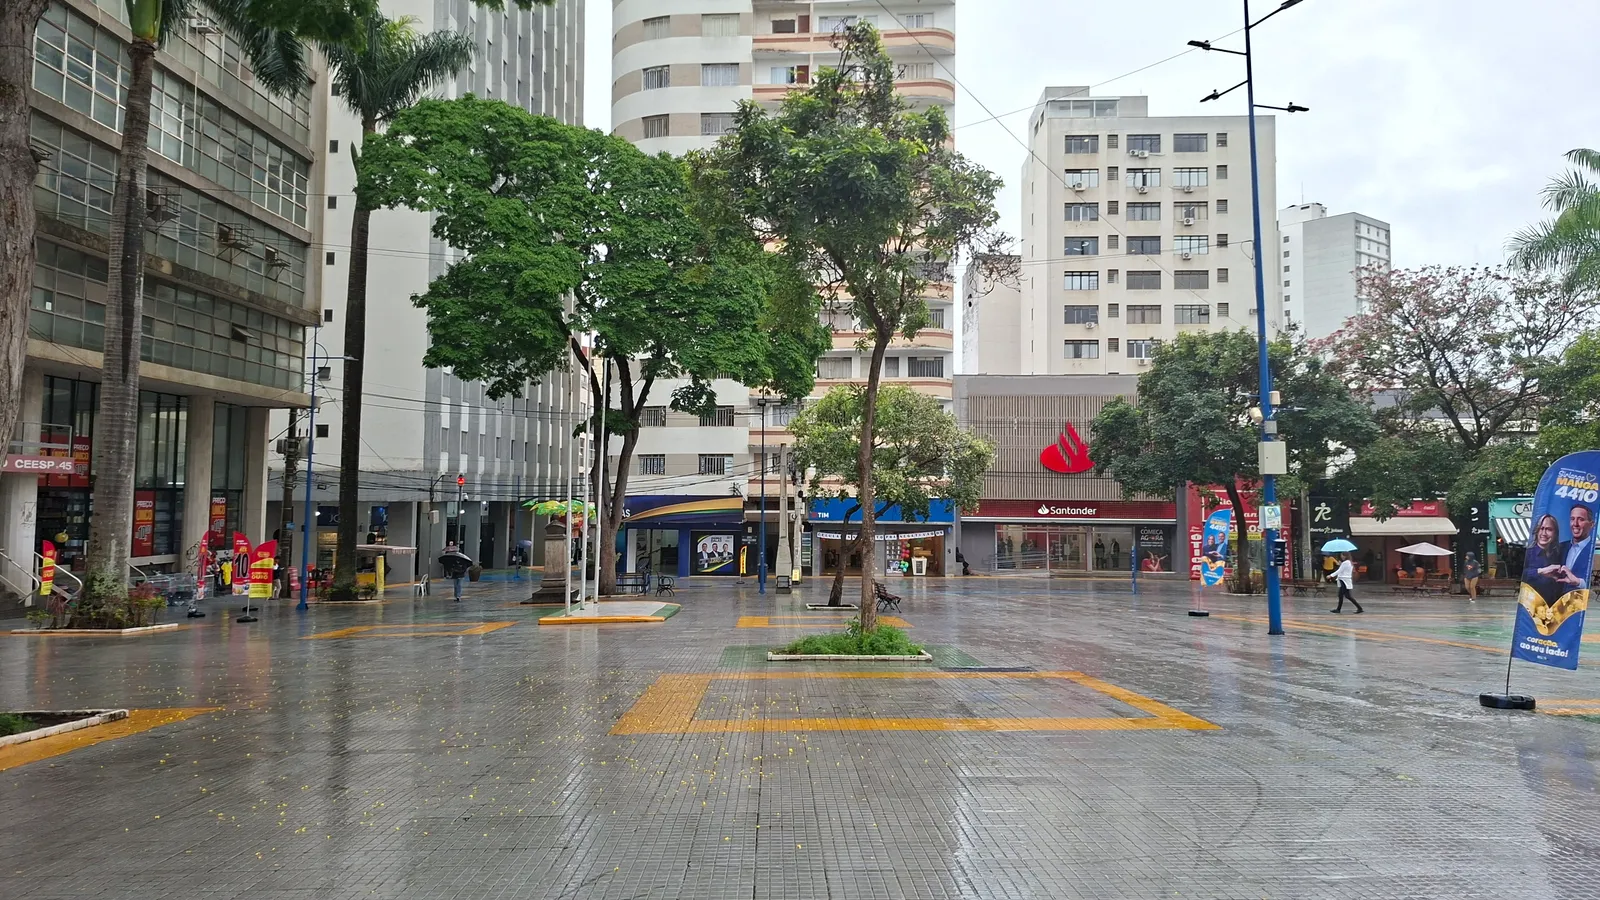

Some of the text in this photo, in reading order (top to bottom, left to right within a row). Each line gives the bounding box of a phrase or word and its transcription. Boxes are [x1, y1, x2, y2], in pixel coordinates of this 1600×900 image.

[14, 459, 55, 469] CEESP
[1556, 477, 1599, 491] MANGA
[1554, 486, 1598, 503] 4410
[1050, 506, 1098, 516] Santander
[1519, 642, 1531, 650] ao
[1531, 645, 1545, 653] seu
[1545, 646, 1569, 658] lado!
